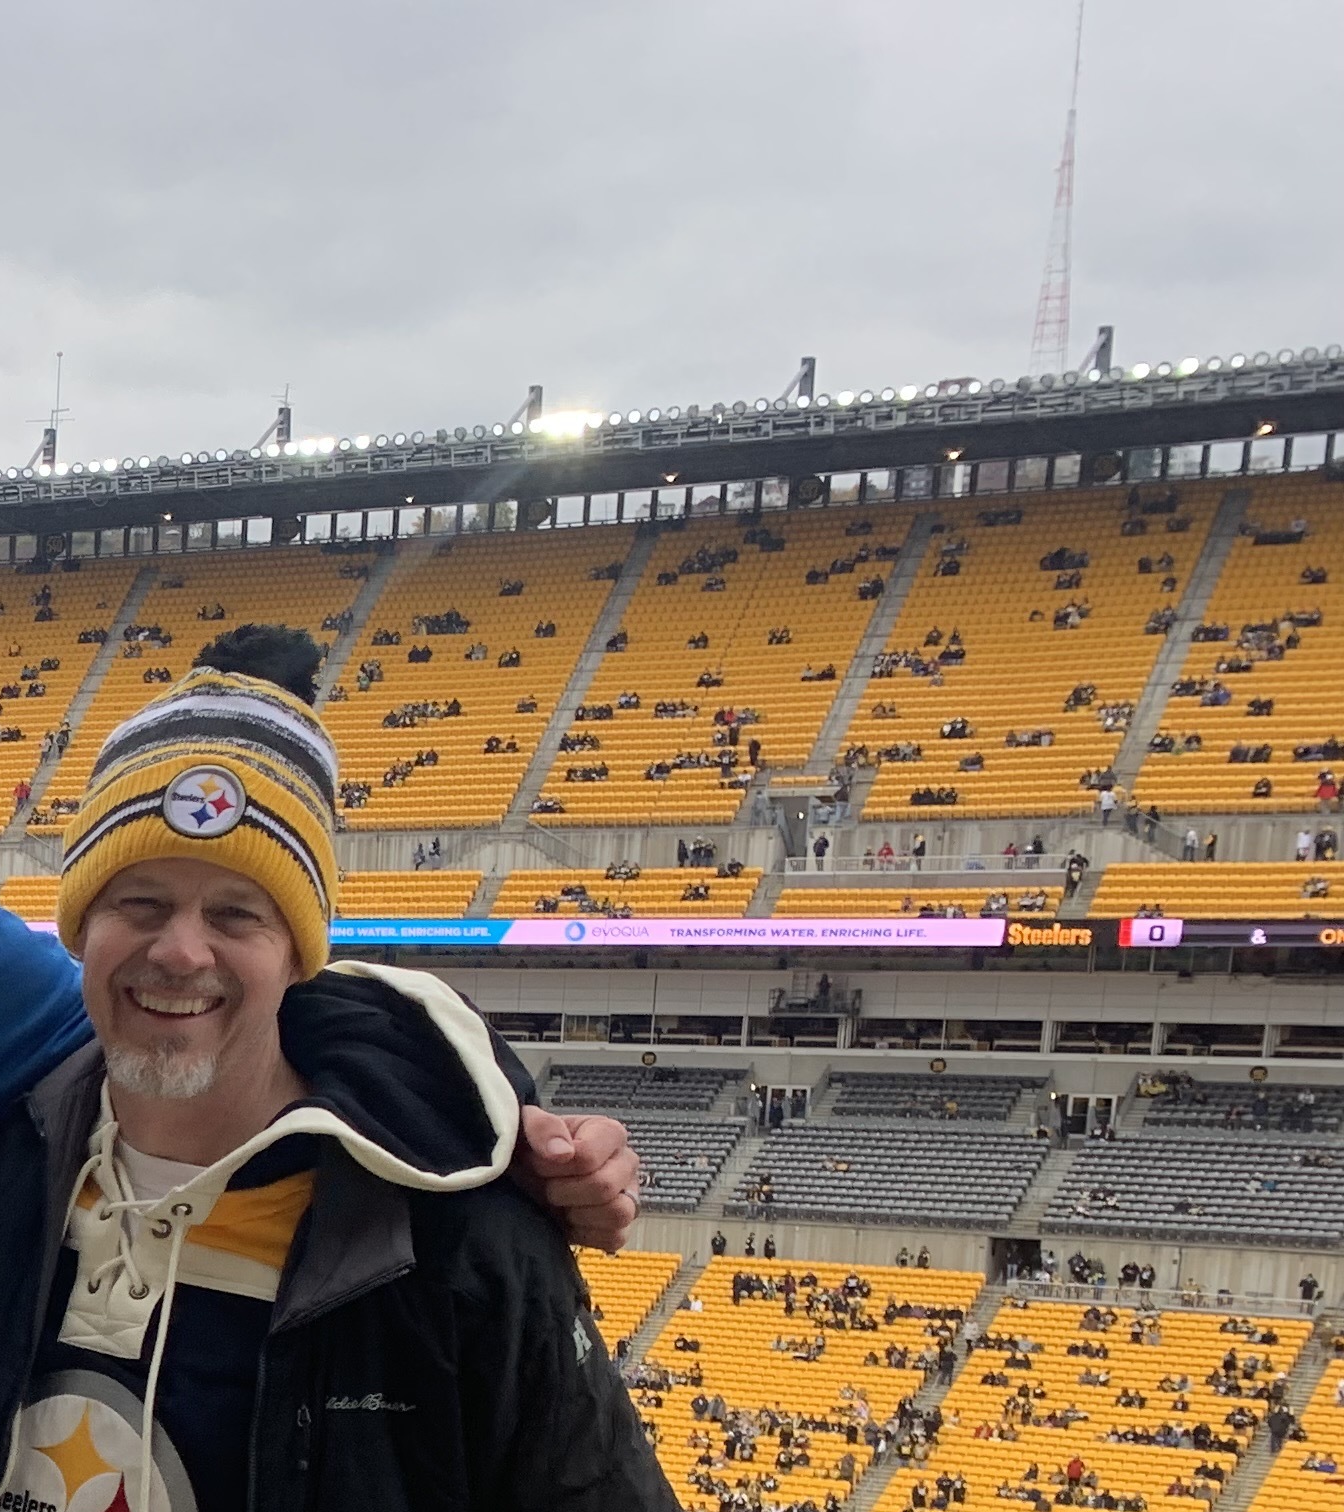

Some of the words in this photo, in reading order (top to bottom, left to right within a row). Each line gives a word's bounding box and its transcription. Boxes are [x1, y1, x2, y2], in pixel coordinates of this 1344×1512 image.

[400, 926, 462, 937] ENRICHING
[670, 927, 767, 938] TRANSFORMING
[821, 928, 893, 938] ENRICHING
[896, 928, 928, 938] LIFE.
[1008, 923, 1092, 946] Steelers
